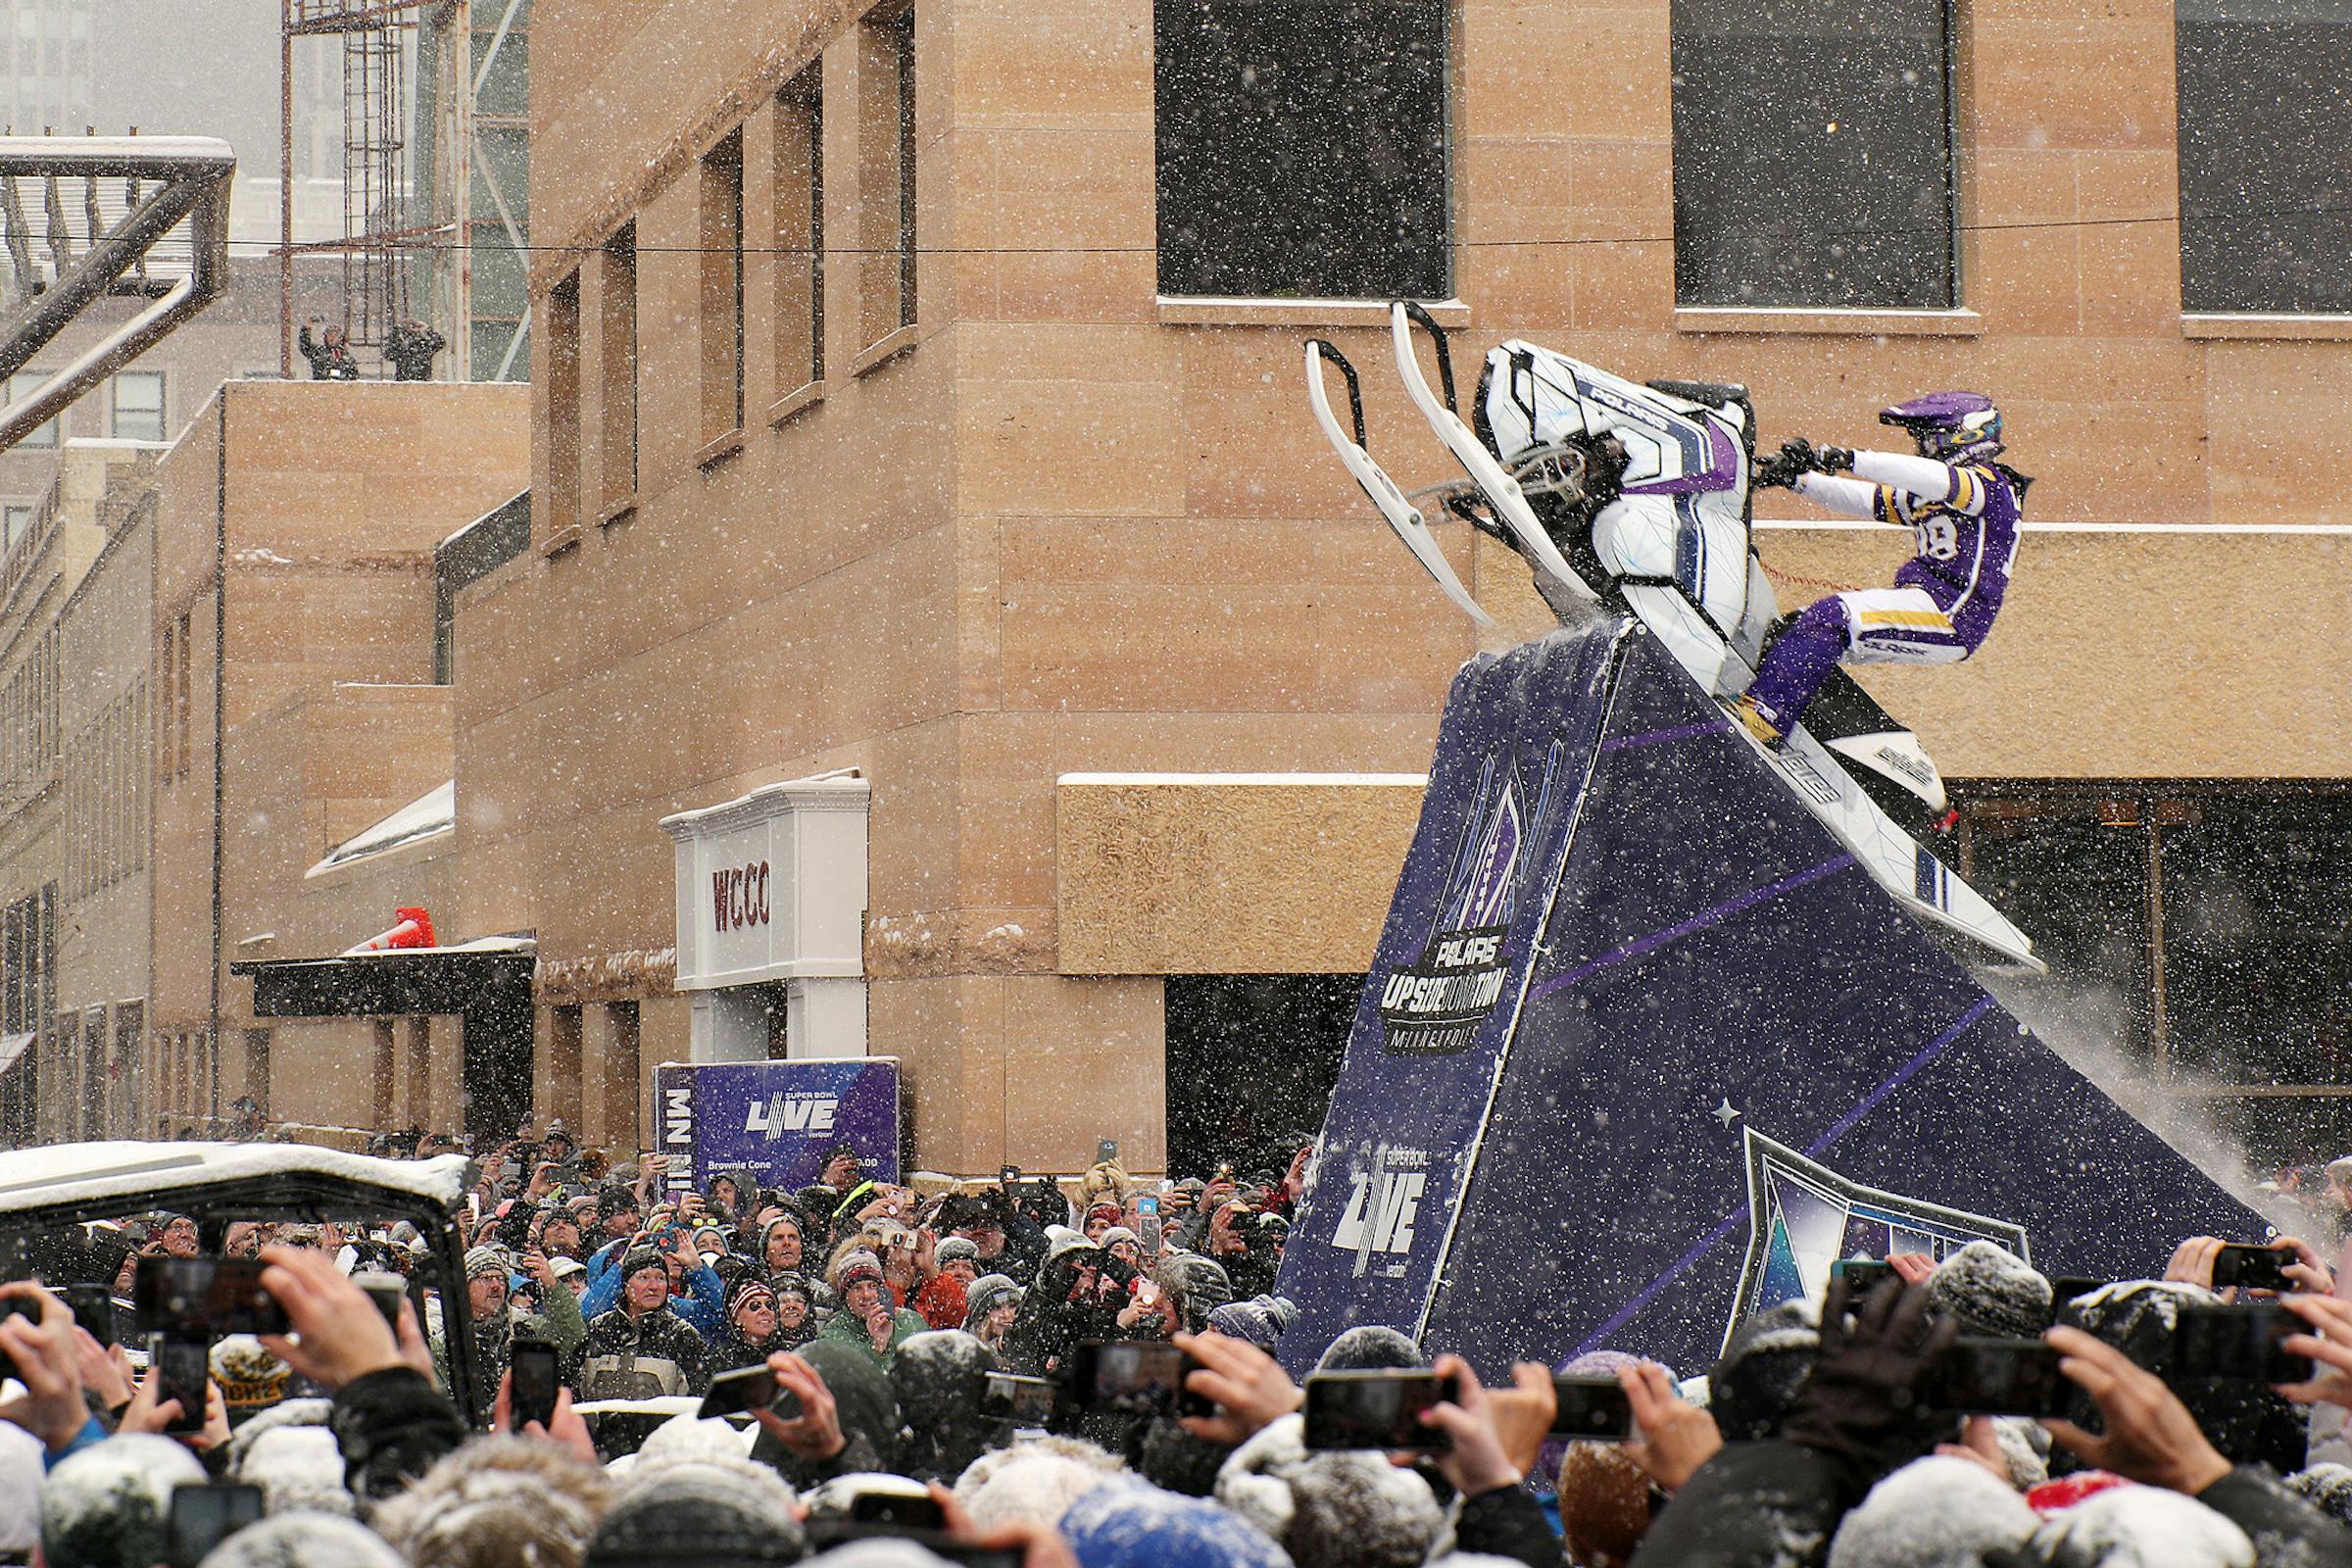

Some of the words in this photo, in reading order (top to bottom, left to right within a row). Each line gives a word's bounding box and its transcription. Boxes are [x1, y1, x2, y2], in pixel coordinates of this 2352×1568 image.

[1589, 386, 1671, 431] POLARIS
[711, 859, 770, 932] WCCO
[1434, 935, 1501, 968] POLARIS
[665, 1088, 692, 1144] MN
[745, 1091, 839, 1141] LIVE
[785, 1092, 813, 1101] SUPER
[814, 1091, 838, 1100] BOWL
[708, 1159, 746, 1170] Brownie
[748, 1159, 772, 1169] Cone
[1331, 1145, 1427, 1278] LIVE
